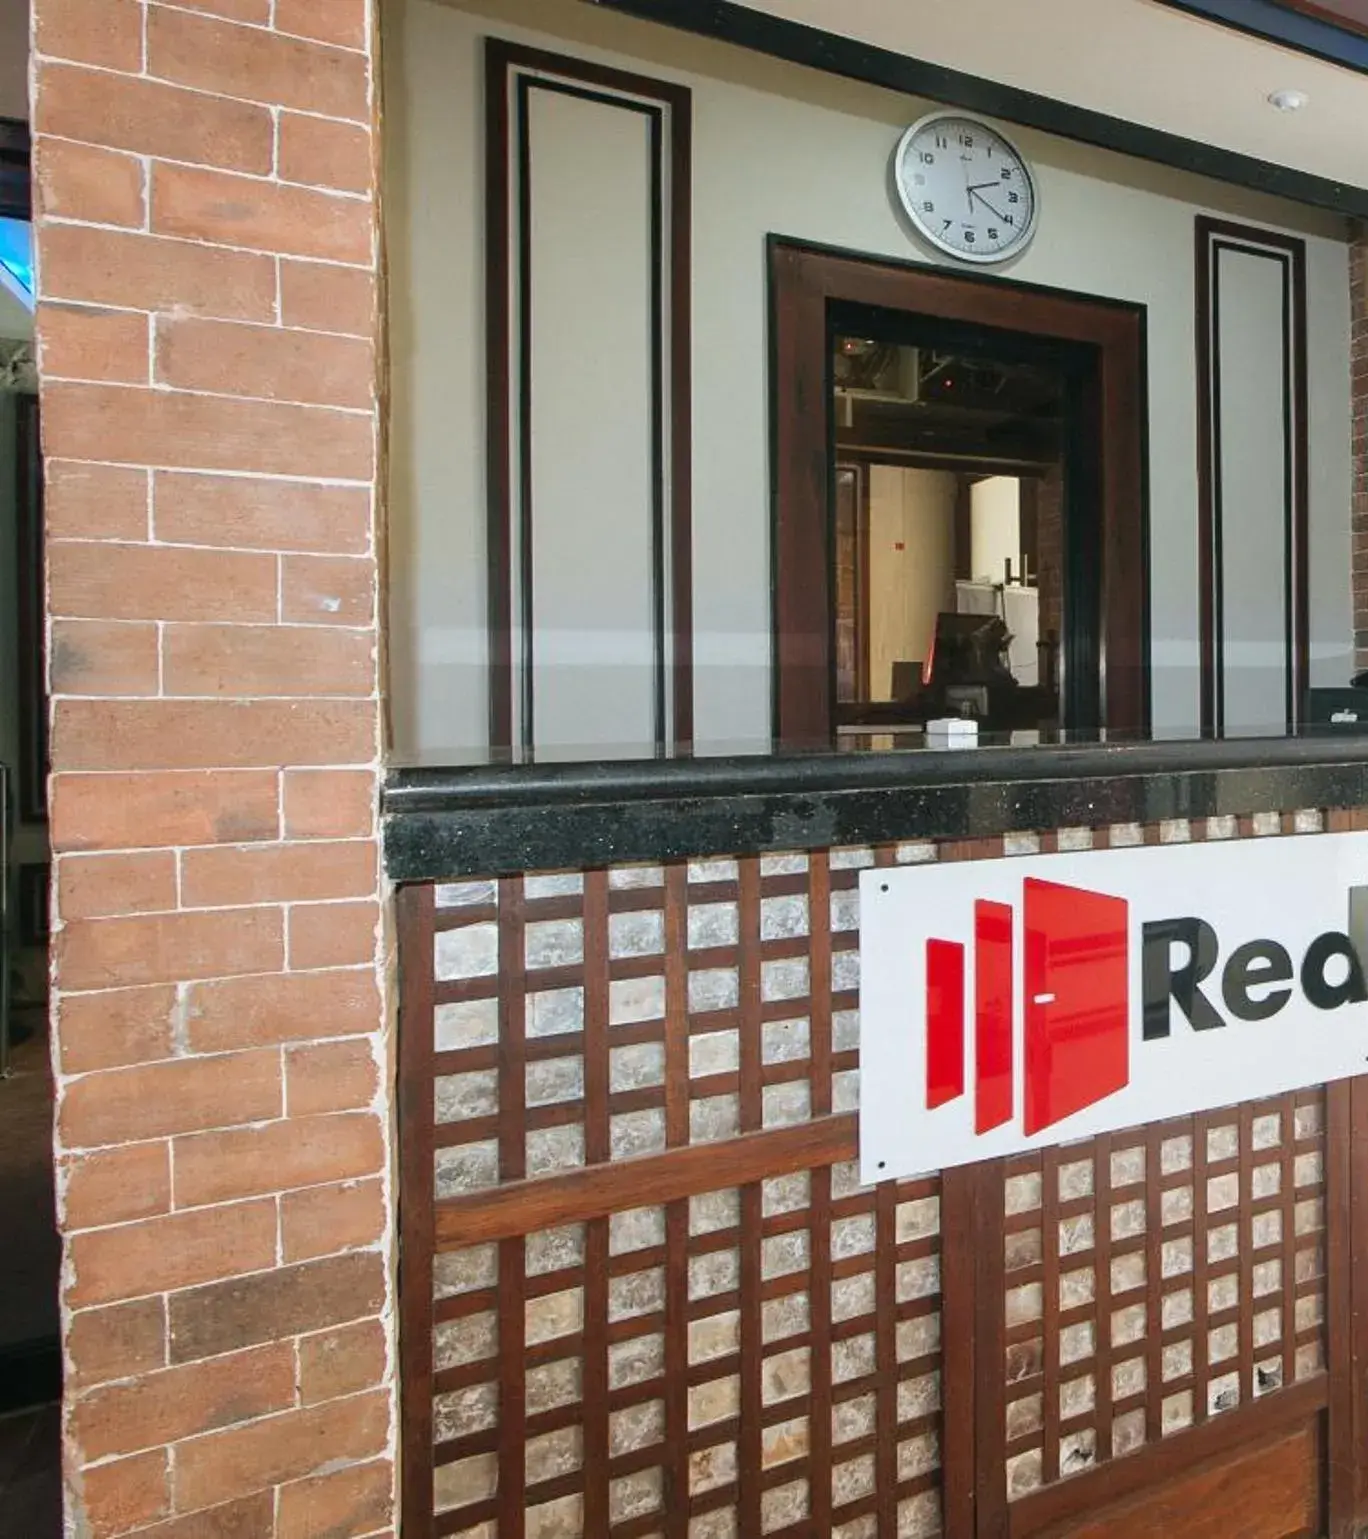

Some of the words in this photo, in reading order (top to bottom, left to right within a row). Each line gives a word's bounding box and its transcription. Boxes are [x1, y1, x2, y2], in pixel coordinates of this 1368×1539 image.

[935, 135, 947, 149] 11
[959, 135, 973, 148] 12
[919, 152, 934, 164] 10
